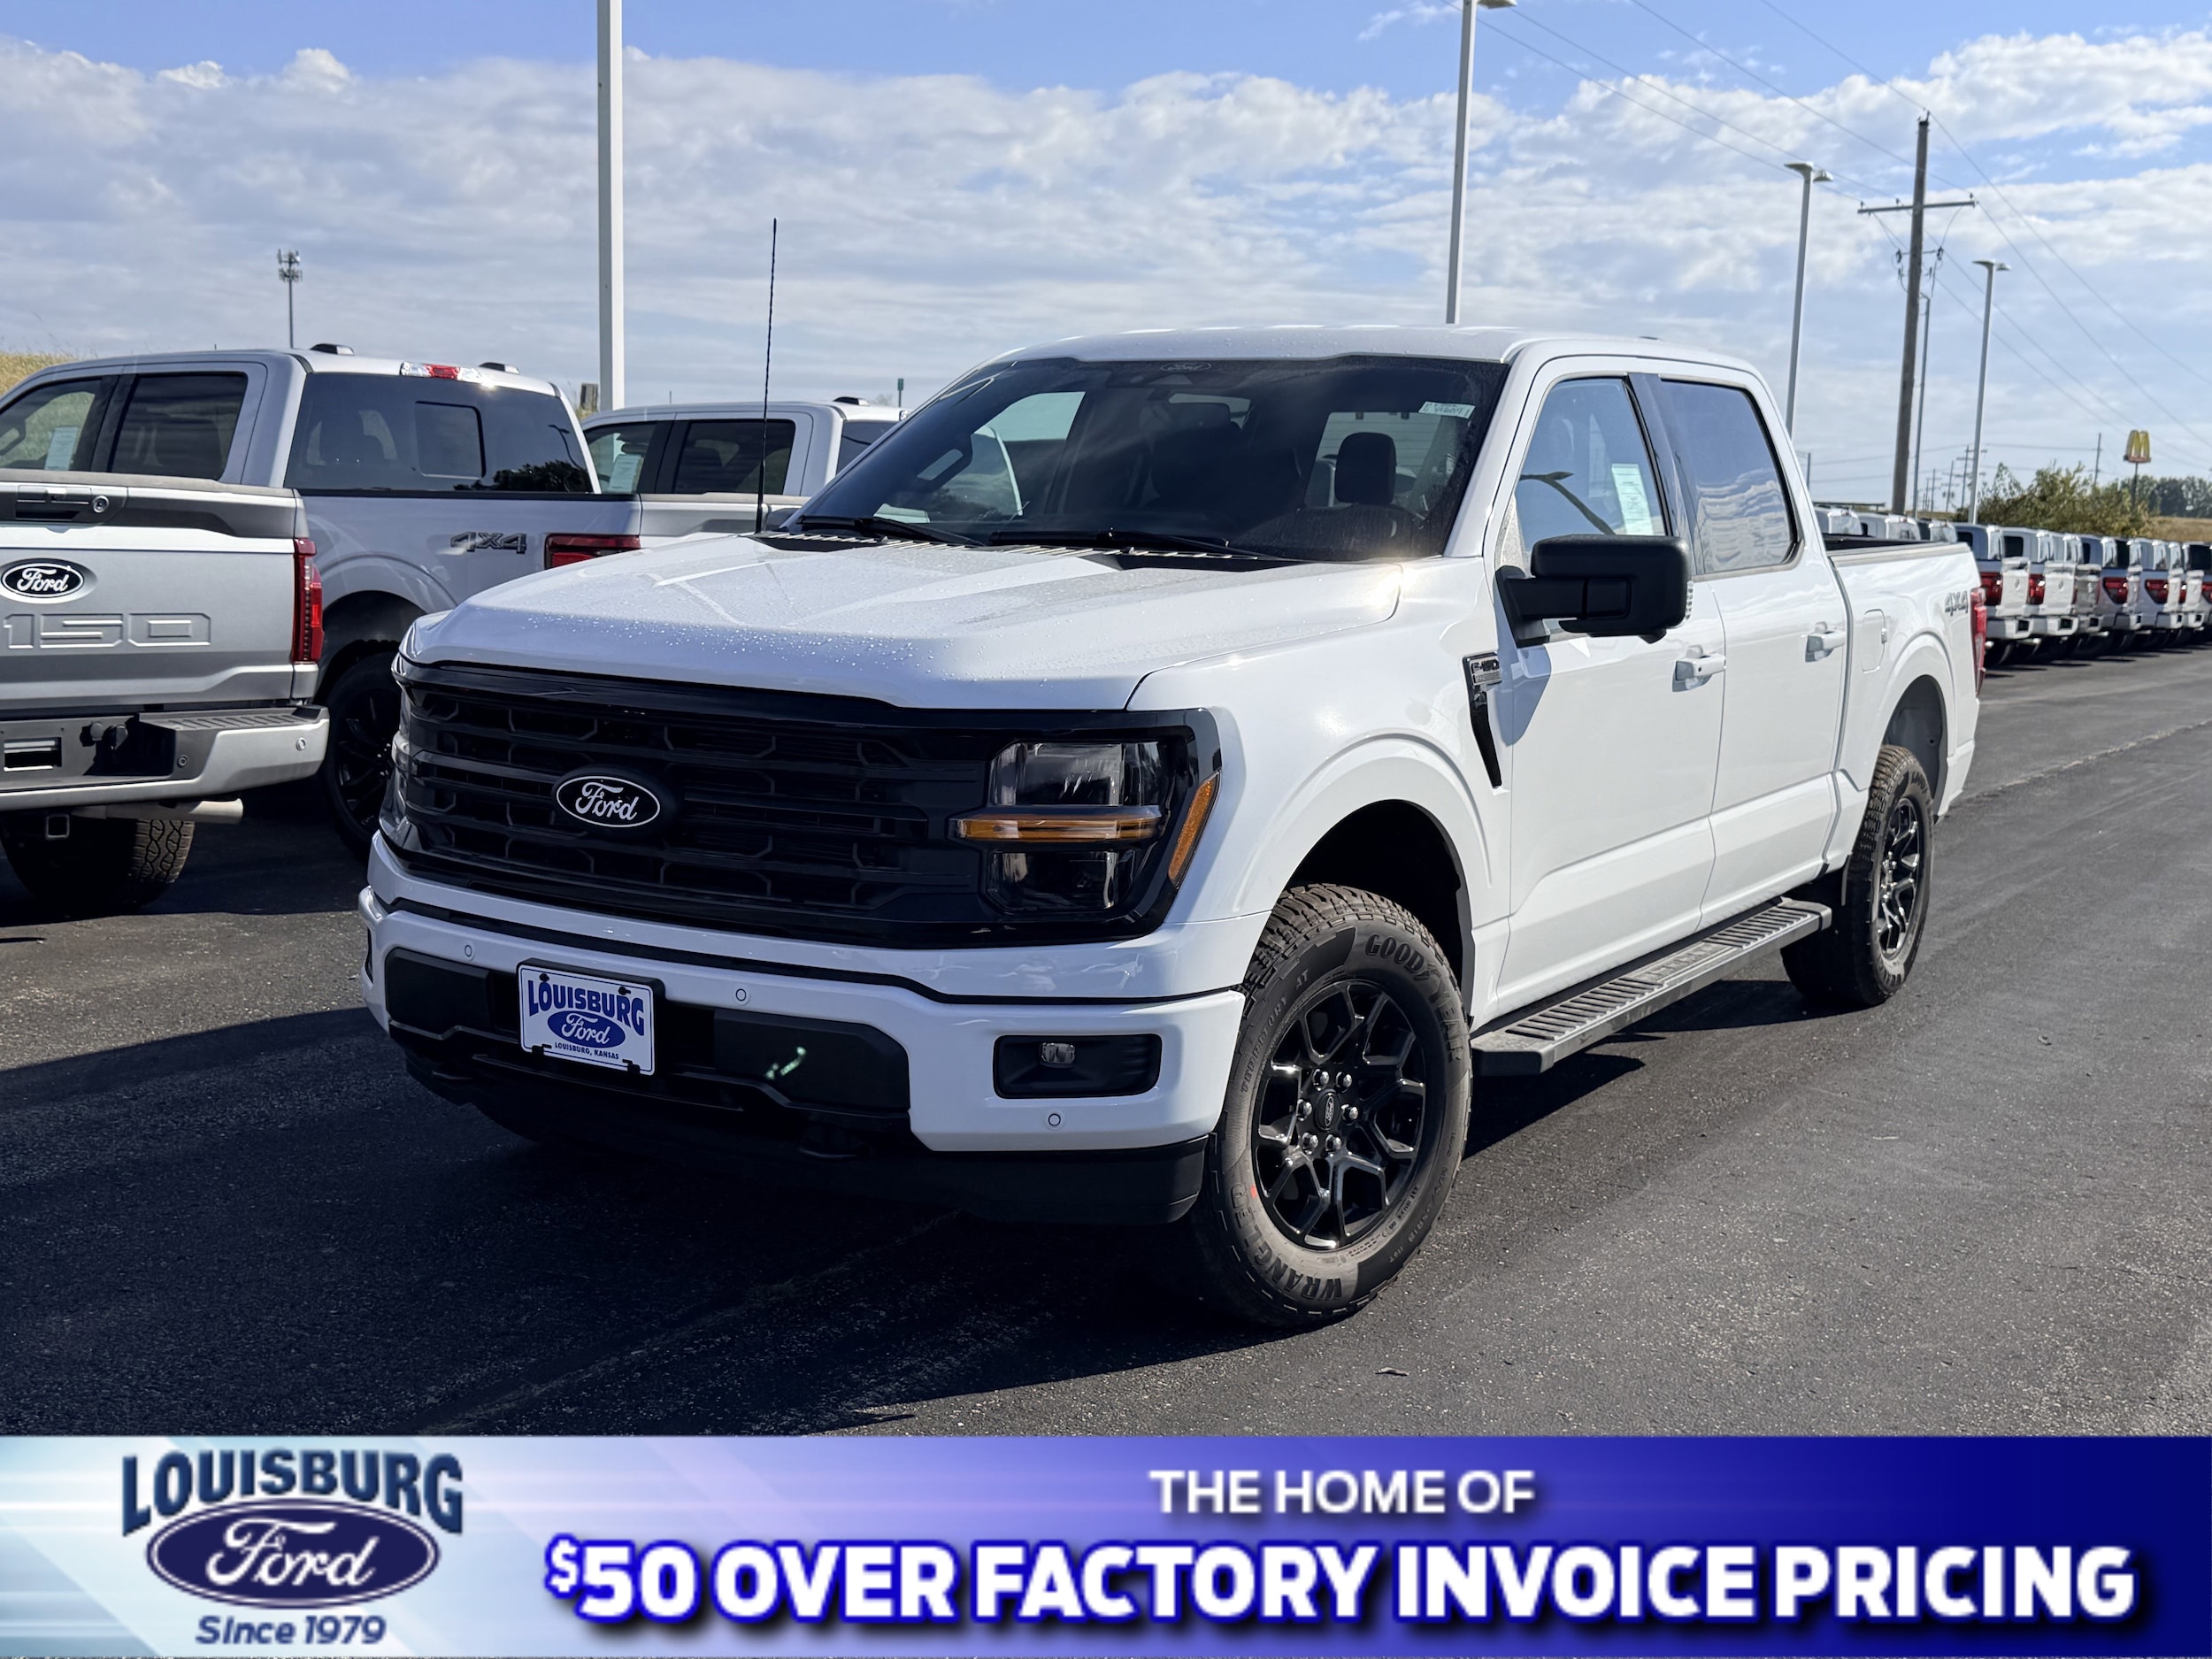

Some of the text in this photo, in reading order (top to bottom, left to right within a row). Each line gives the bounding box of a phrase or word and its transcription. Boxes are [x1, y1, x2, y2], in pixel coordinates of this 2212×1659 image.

[16, 567, 70, 592] Ford
[4, 612, 211, 649] 150
[575, 781, 640, 821] Ford
[527, 979, 645, 1036] LOUISBURG
[561, 1012, 611, 1045] Ford
[555, 1041, 620, 1060] LOUISBURG, KANSAS
